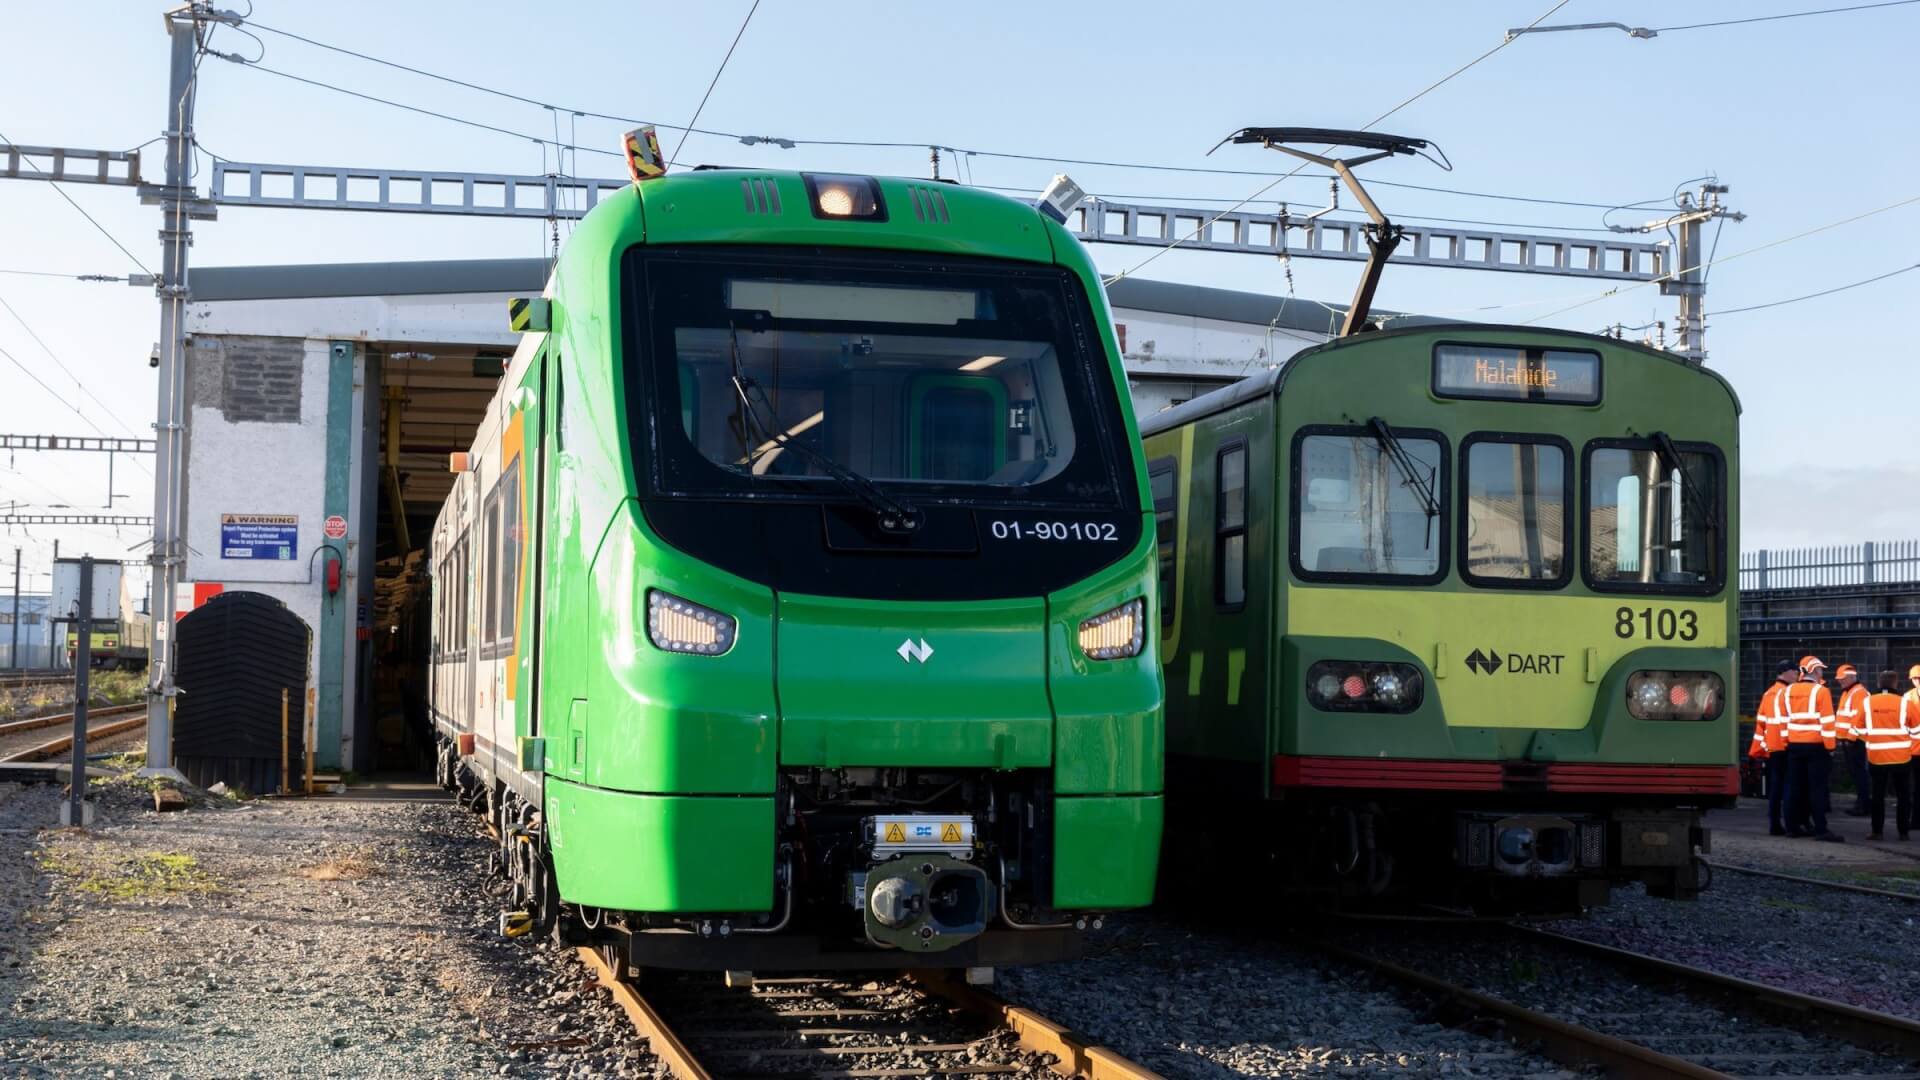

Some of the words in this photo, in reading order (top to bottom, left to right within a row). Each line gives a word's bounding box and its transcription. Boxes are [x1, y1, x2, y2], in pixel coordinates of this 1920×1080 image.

[1475, 359, 1557, 387] Malahide
[239, 516, 295, 524] WARNING
[327, 520, 345, 528] STOP
[992, 521, 1119, 541] 01-90102
[1614, 606, 1698, 641] 8103
[1508, 653, 1565, 674] DART
